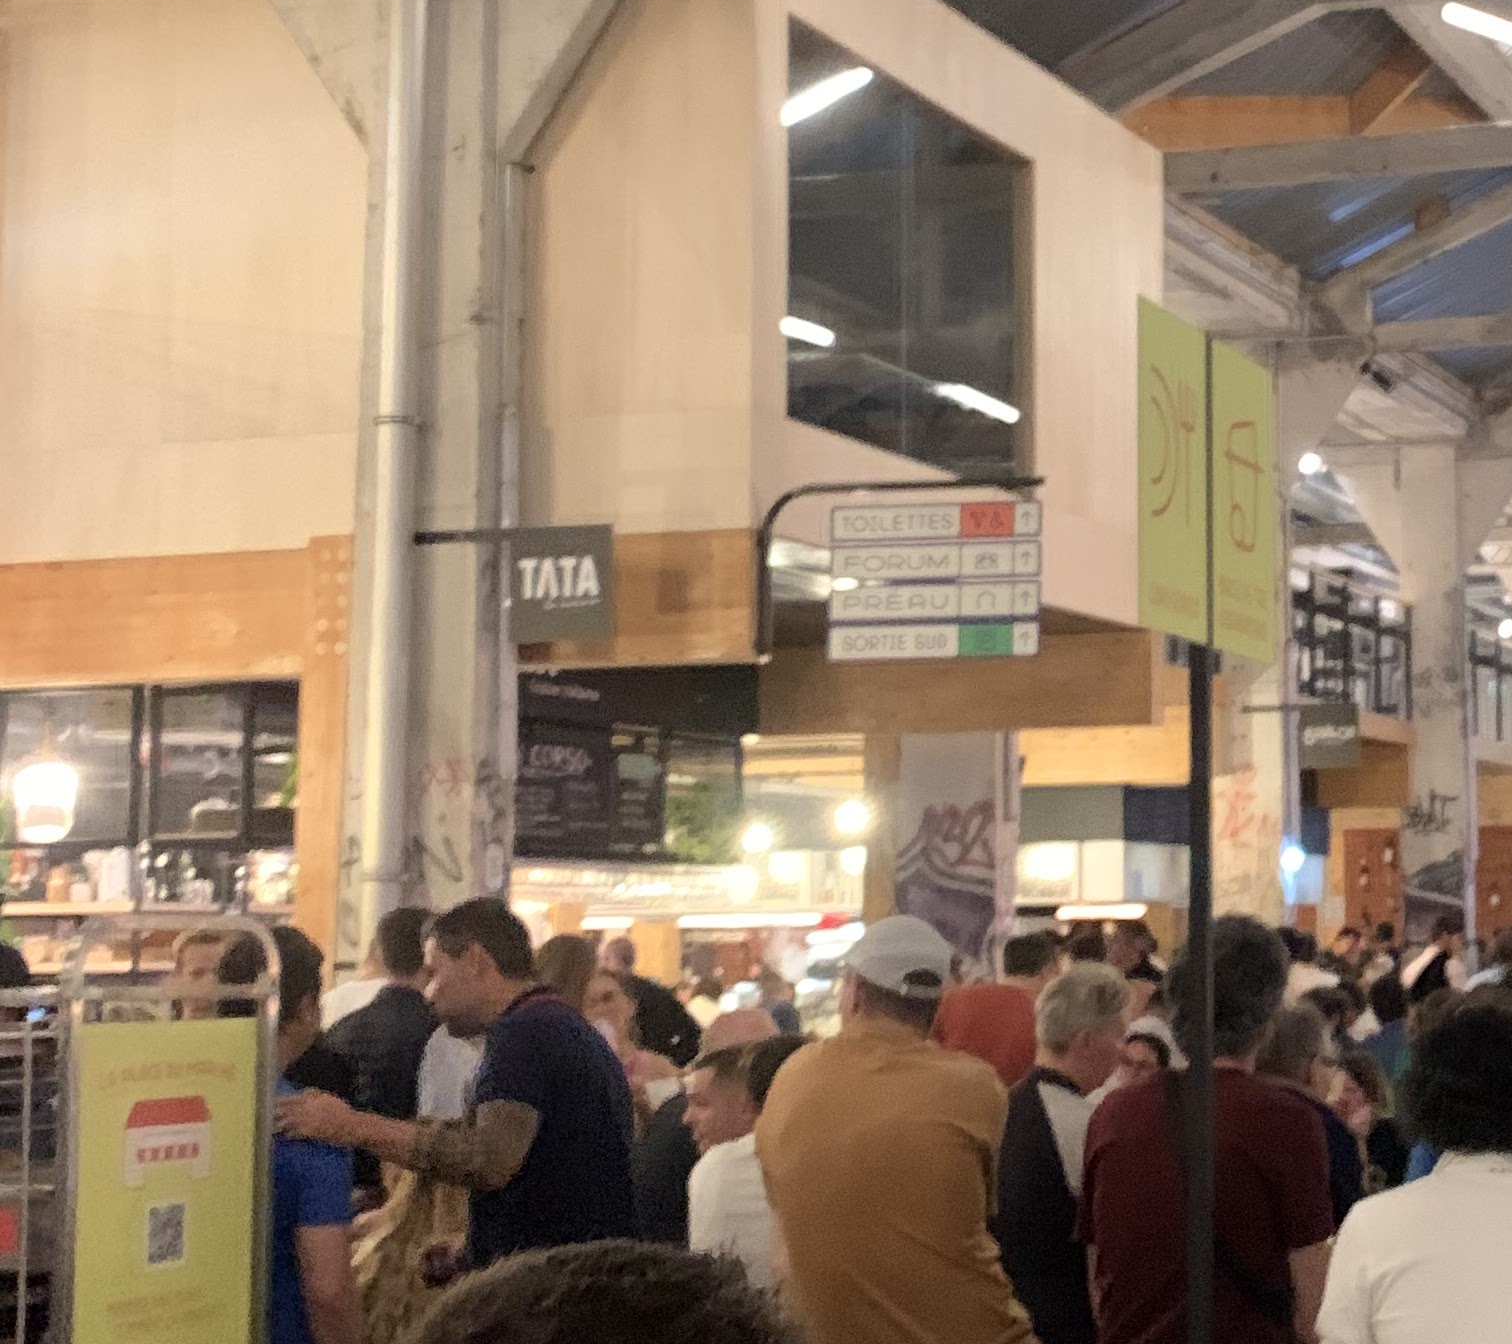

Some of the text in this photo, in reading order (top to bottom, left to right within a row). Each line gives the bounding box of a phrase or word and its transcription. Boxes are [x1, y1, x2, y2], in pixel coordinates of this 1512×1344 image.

[842, 512, 954, 534] TOILETTES
[844, 553, 950, 572] FORUM
[517, 555, 600, 600] TATA
[842, 631, 949, 652] SORTIE SUD
